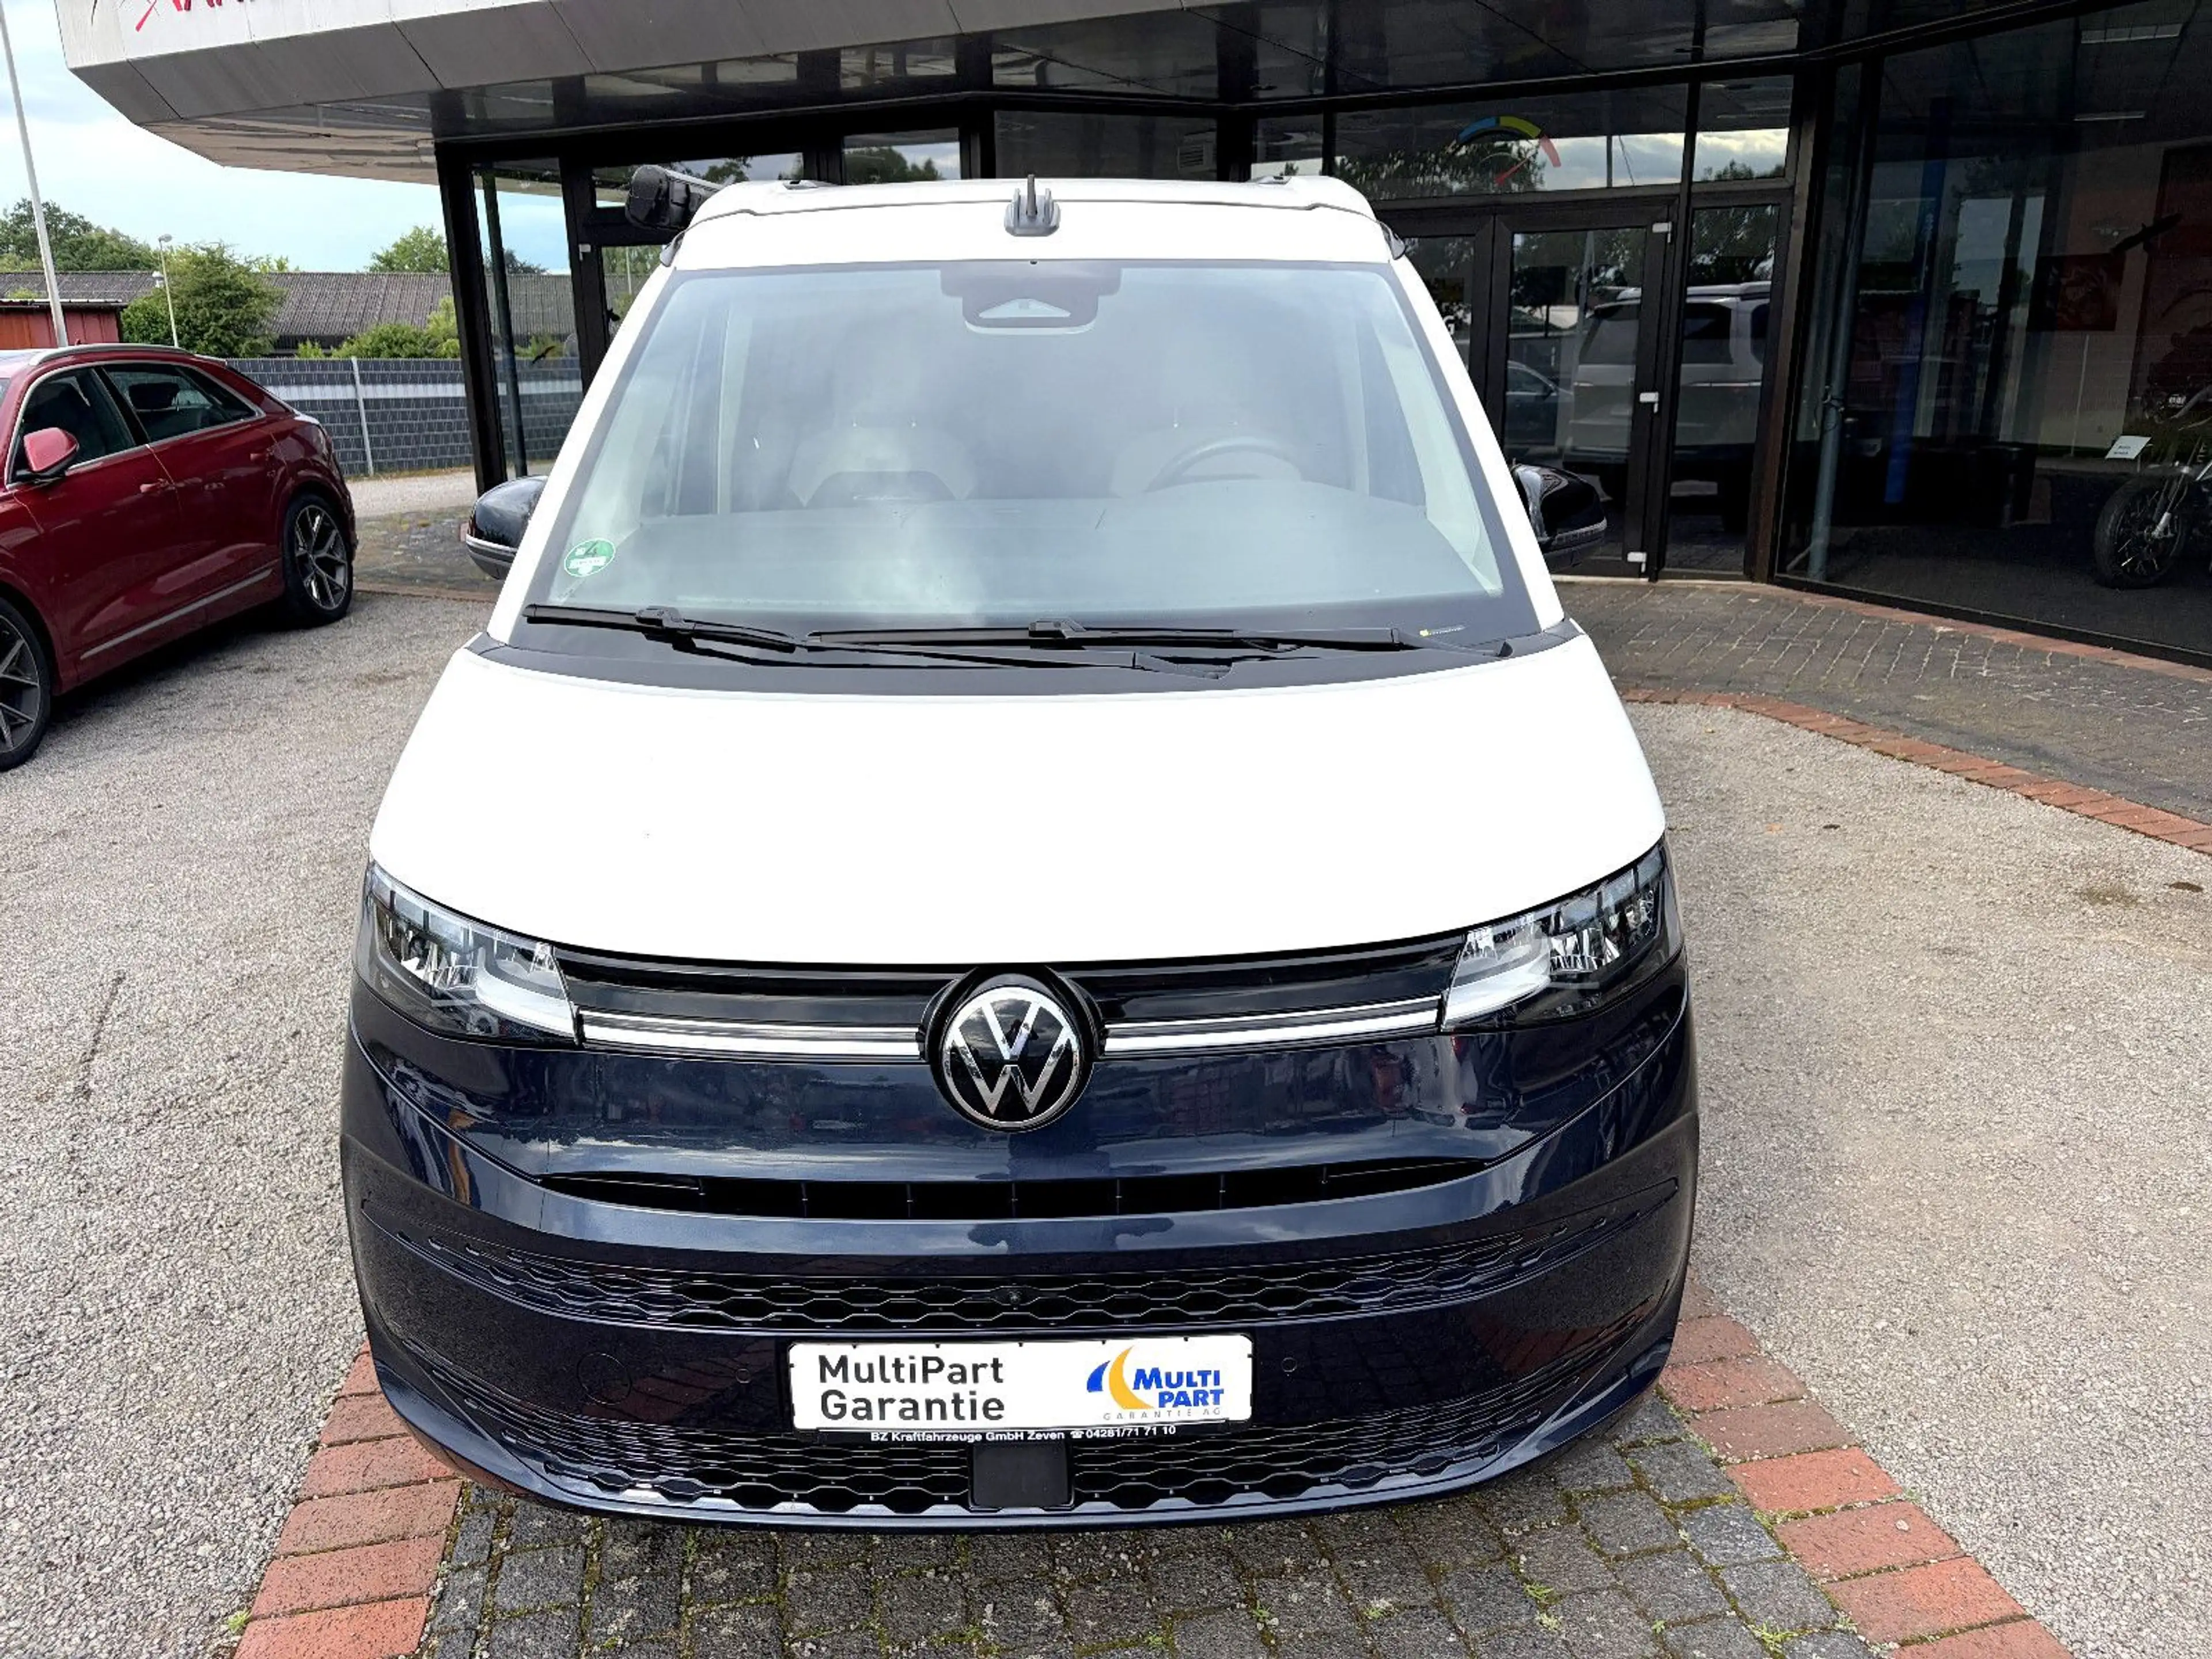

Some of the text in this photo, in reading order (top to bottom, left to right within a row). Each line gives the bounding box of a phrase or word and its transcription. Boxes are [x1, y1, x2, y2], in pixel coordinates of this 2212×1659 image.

[819, 1355, 1003, 1383] MultiPart
[821, 1389, 1005, 1421] Garantie
[1158, 1389, 1224, 1408] PART
[1103, 1407, 1221, 1421] GARANTIE AG
[871, 1432, 888, 1441] BZ
[892, 1432, 982, 1442] Kraftfahrzeuge
[986, 1431, 1024, 1440] GmbH
[1028, 1431, 1065, 1440] Zeven
[1144, 1426, 1157, 1436] 71
[1162, 1425, 1176, 1434] 10
